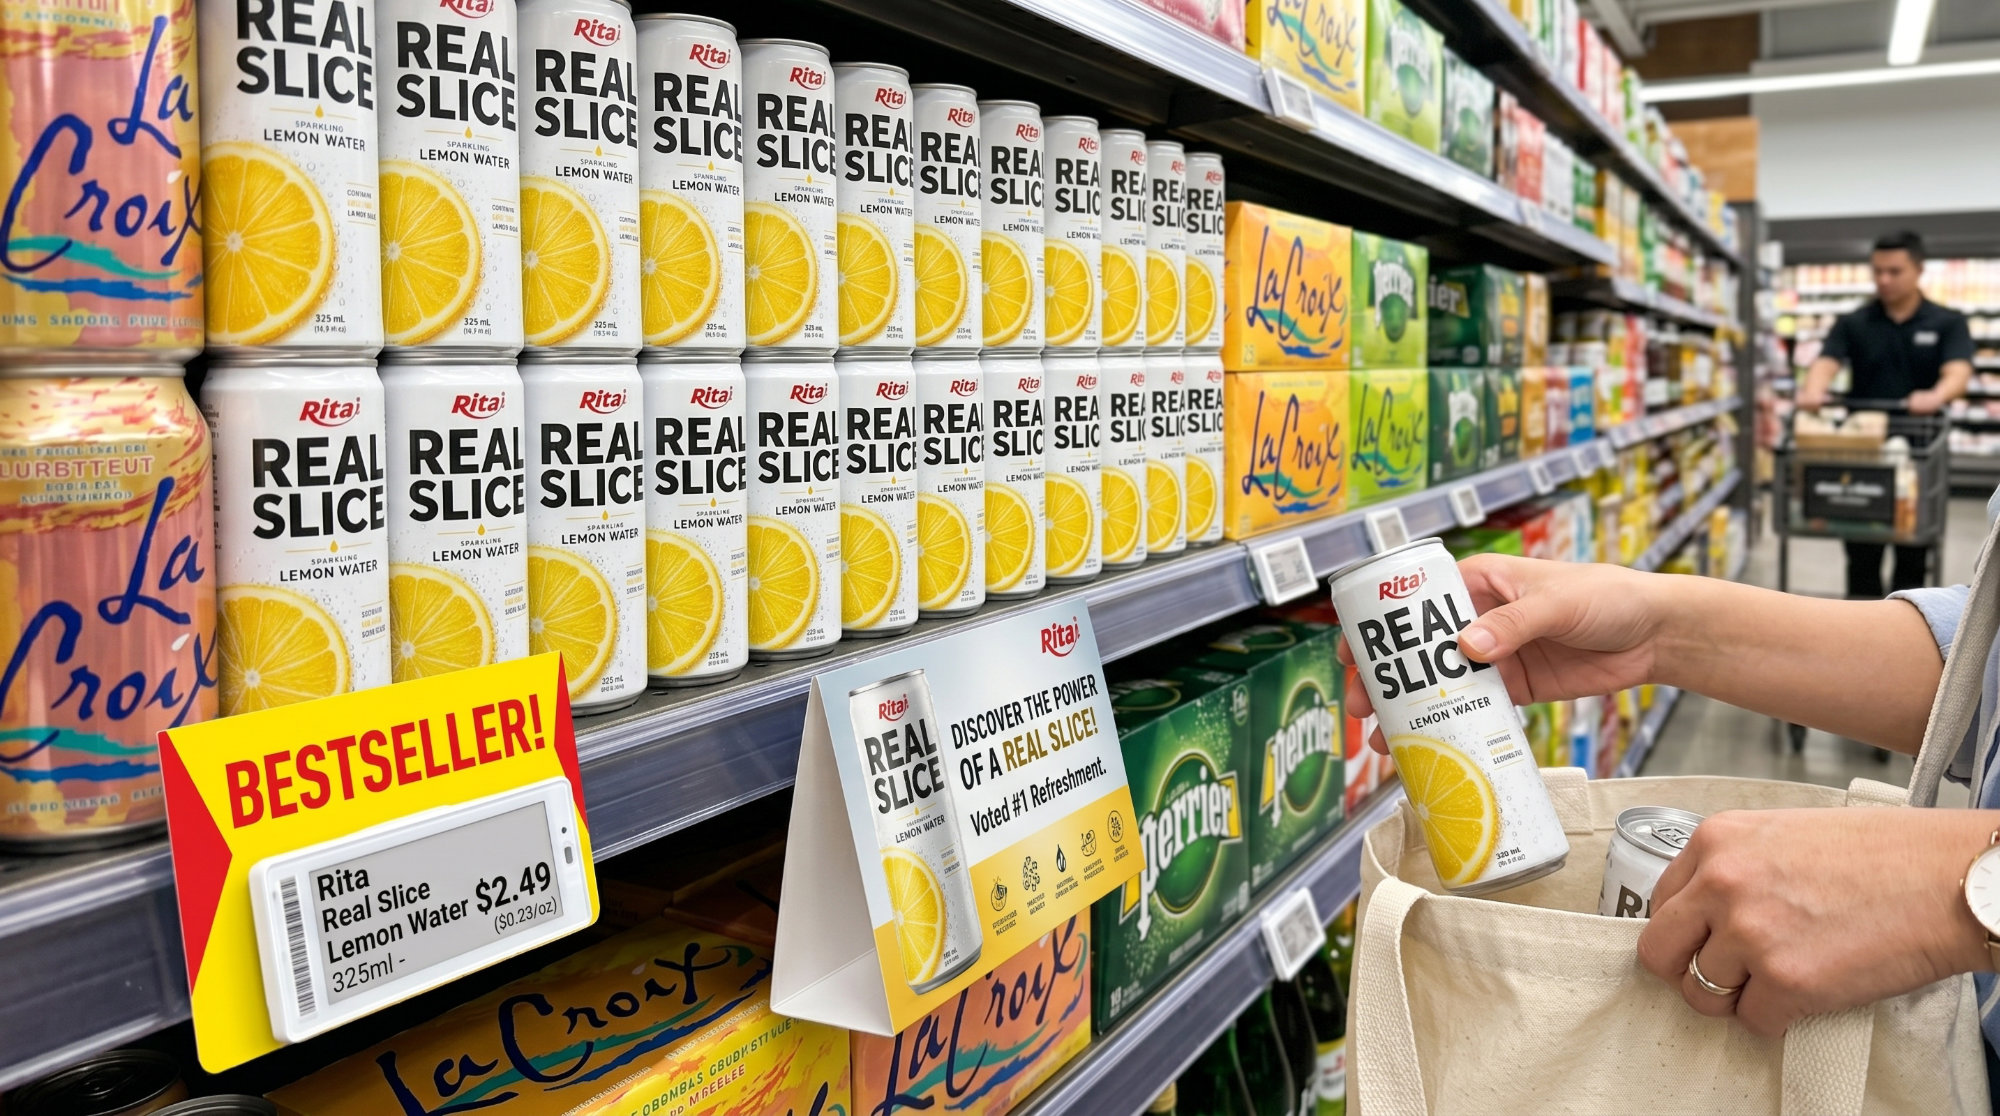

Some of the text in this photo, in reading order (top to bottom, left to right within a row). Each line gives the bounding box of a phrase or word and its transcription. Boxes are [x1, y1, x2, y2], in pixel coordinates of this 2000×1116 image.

[236, 0, 372, 58] REAL
[574, 18, 620, 46] Rita
[397, 21, 515, 84] REAL
[690, 44, 731, 70] Rita
[107, 15, 194, 159] La
[236, 47, 373, 110] SLICE
[535, 49, 636, 106] REAL
[790, 66, 826, 90] Rita
[396, 74, 516, 132] SLICE
[654, 72, 742, 124] REAL
[874, 88, 906, 110] Rita
[534, 97, 638, 149] SLICE
[757, 93, 836, 139] REAL
[948, 107, 976, 128] Rita
[264, 129, 366, 152] LEMON WATER
[447, 141, 489, 152] SPARKLING
[654, 116, 742, 164] SLICE
[756, 134, 836, 176] SLICE
[420, 149, 510, 169] LEMON WATER
[555, 166, 634, 184] LEMON WATER
[580, 158, 618, 168] SPARKLING
[0, 113, 204, 273] Croix
[672, 180, 740, 197] LEMON WATER
[774, 192, 834, 208] LEMON WATER
[860, 204, 893, 215] LEMON
[934, 215, 961, 225] LEMON
[1002, 223, 1030, 232] LEMON
[316, 314, 346, 324] 325 mL
[464, 318, 478, 327] 325
[594, 321, 606, 329] 325
[580, 388, 626, 414] Rita
[690, 386, 733, 410] Rita
[790, 383, 828, 405] Rita
[876, 381, 909, 400] Rita
[950, 378, 978, 397] Rita
[1018, 376, 1041, 394] Rita
[300, 397, 360, 427] Rita
[451, 392, 506, 420] Rita
[847, 406, 916, 440] REAL
[540, 421, 643, 465] REAL
[655, 416, 746, 456] REAL
[758, 411, 839, 448] REAL
[252, 434, 384, 488] REAL
[409, 426, 524, 475] REAL
[758, 448, 840, 484] SLICE
[540, 464, 644, 508] SLICE
[655, 456, 746, 496] SLICE
[938, 482, 966, 493] LEMON
[1006, 474, 1031, 482] LEMON
[252, 485, 384, 539] SLICE
[409, 474, 524, 522] SLICE
[775, 502, 836, 516] LEMON WATER
[862, 493, 894, 504] LEMON
[561, 528, 639, 545] LEMON WATER
[674, 514, 742, 530] LEMON WATER
[97, 476, 205, 626] La
[311, 554, 358, 566] SPARKLING
[432, 542, 520, 562] LEMON WATER
[280, 560, 378, 582] LEMON WATER
[1378, 572, 1427, 600] Rita
[1041, 616, 1080, 658] Rita
[1358, 593, 1472, 662] REAL
[0, 600, 218, 763] Croix
[878, 694, 909, 722] Rita
[950, 674, 1098, 750] DISCOVER THE POWER
[1409, 710, 1450, 730] LEMON
[1452, 696, 1492, 716] WATER
[224, 693, 546, 829] BESTSELLER!
[864, 718, 938, 776] REAL
[960, 706, 1098, 790] OF A REAL SLICE!
[1271, 692, 1335, 828] perrier
[874, 755, 945, 815] SLICE
[970, 756, 1108, 837] Voted #1 Refreshment.
[895, 814, 946, 844] LEMON WATER
[1137, 766, 1233, 941] perrier
[317, 868, 370, 902] Rita
[475, 861, 551, 914] $2.49
[322, 880, 431, 933] Real Slice
[494, 896, 558, 935] ($0.23/oz)
[326, 896, 469, 964] Lemon Water
[332, 952, 394, 994] 325ml
